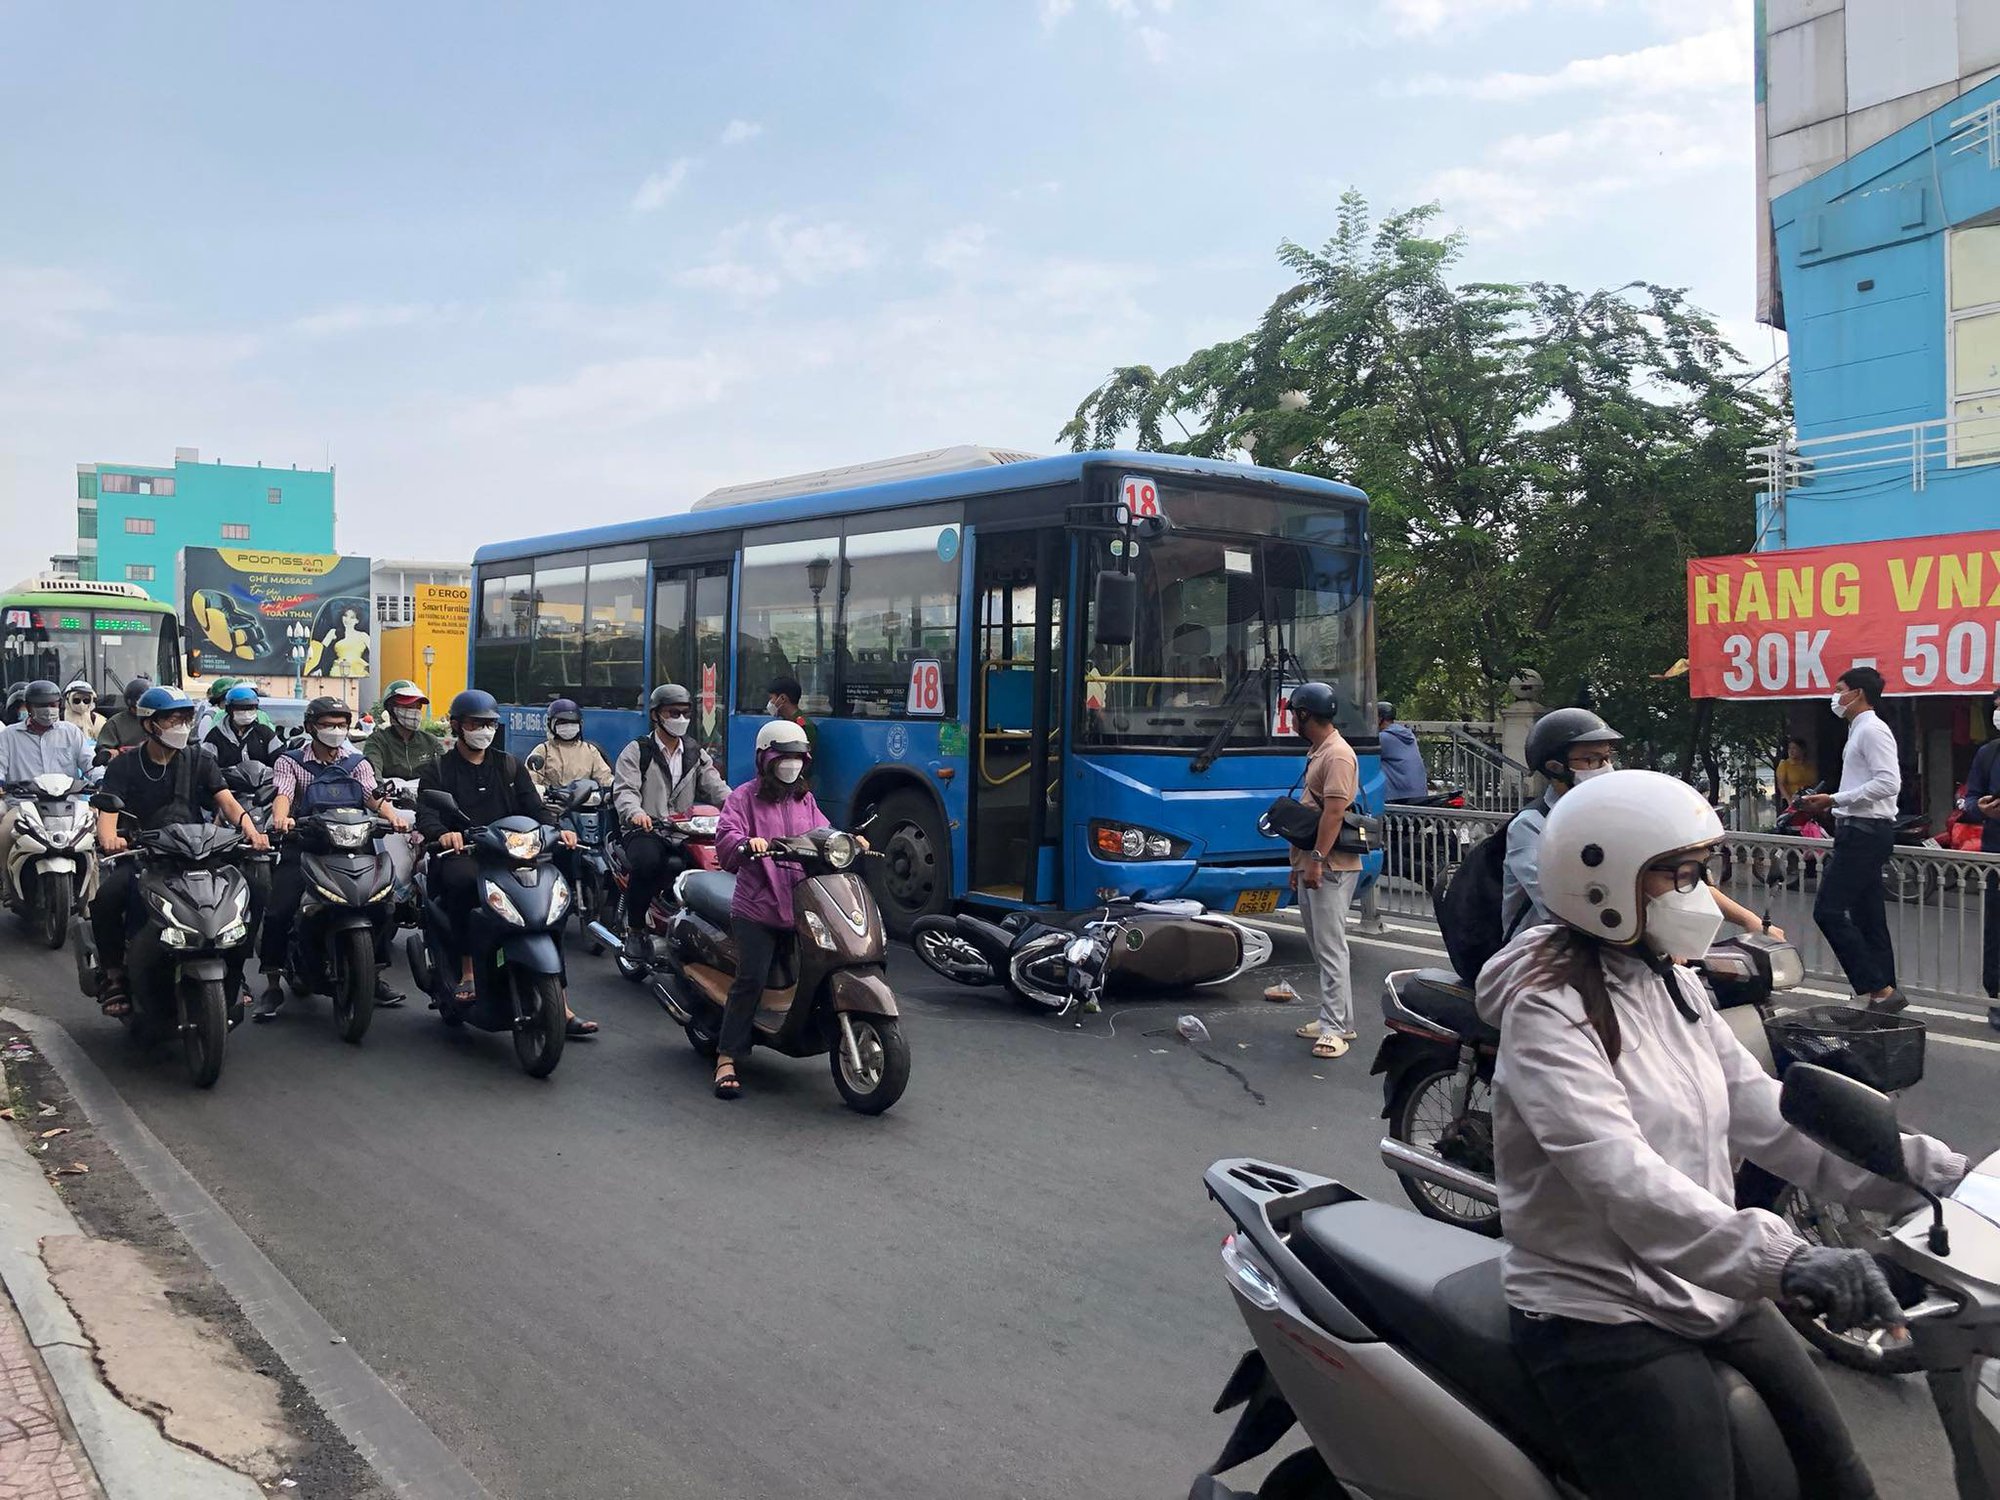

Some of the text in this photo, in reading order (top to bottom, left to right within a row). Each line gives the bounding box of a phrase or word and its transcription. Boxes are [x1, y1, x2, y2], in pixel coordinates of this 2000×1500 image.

[1126, 484, 1156, 519] 18
[237, 554, 323, 567] POONGSAN
[270, 577, 313, 585] MASSAGE
[1695, 559, 1860, 625] HÀNG
[422, 602, 469, 613] Smart Furnitu
[11, 611, 26, 626] 31
[1723, 630, 1831, 692] 30K
[1902, 621, 2000, 687] 50
[913, 666, 939, 709] 18
[510, 712, 549, 731] 51B-056.9
[1249, 890, 1270, 901] 51B
